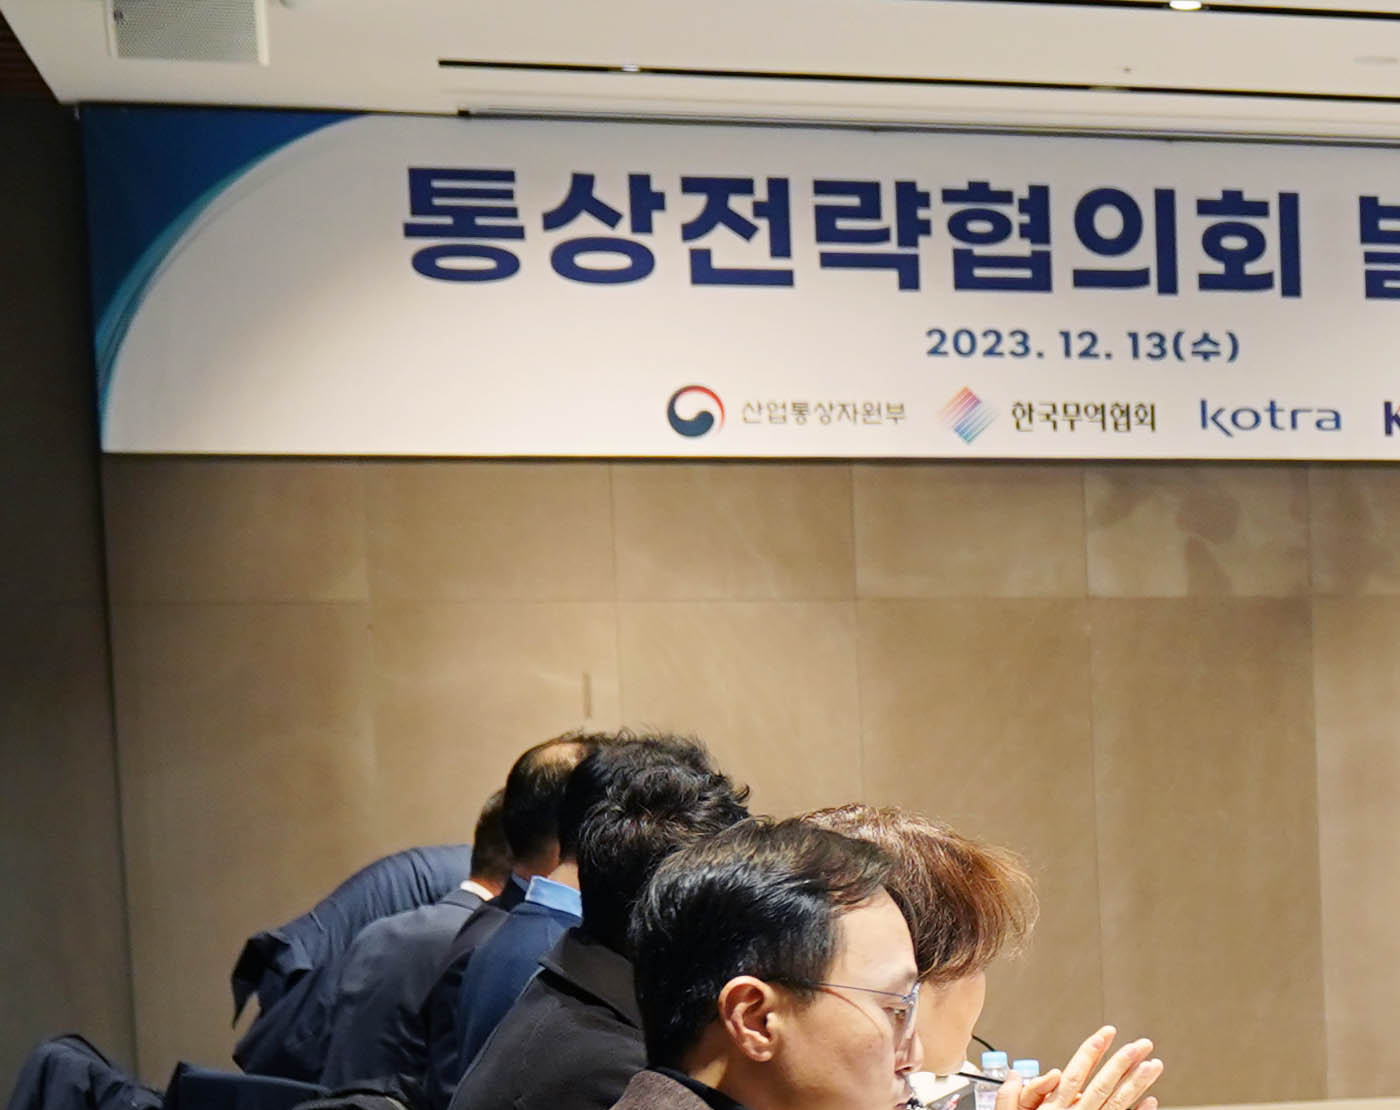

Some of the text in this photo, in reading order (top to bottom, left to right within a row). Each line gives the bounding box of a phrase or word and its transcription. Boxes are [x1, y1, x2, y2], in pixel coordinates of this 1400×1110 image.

[403, 166, 1303, 298] 통상전략협의회
[925, 328, 1240, 362] 2023. 12. 13(수)
[740, 399, 907, 427] 산업통상자원부
[1010, 400, 1157, 434] 한국무역협회
[1199, 398, 1342, 437] kotra
